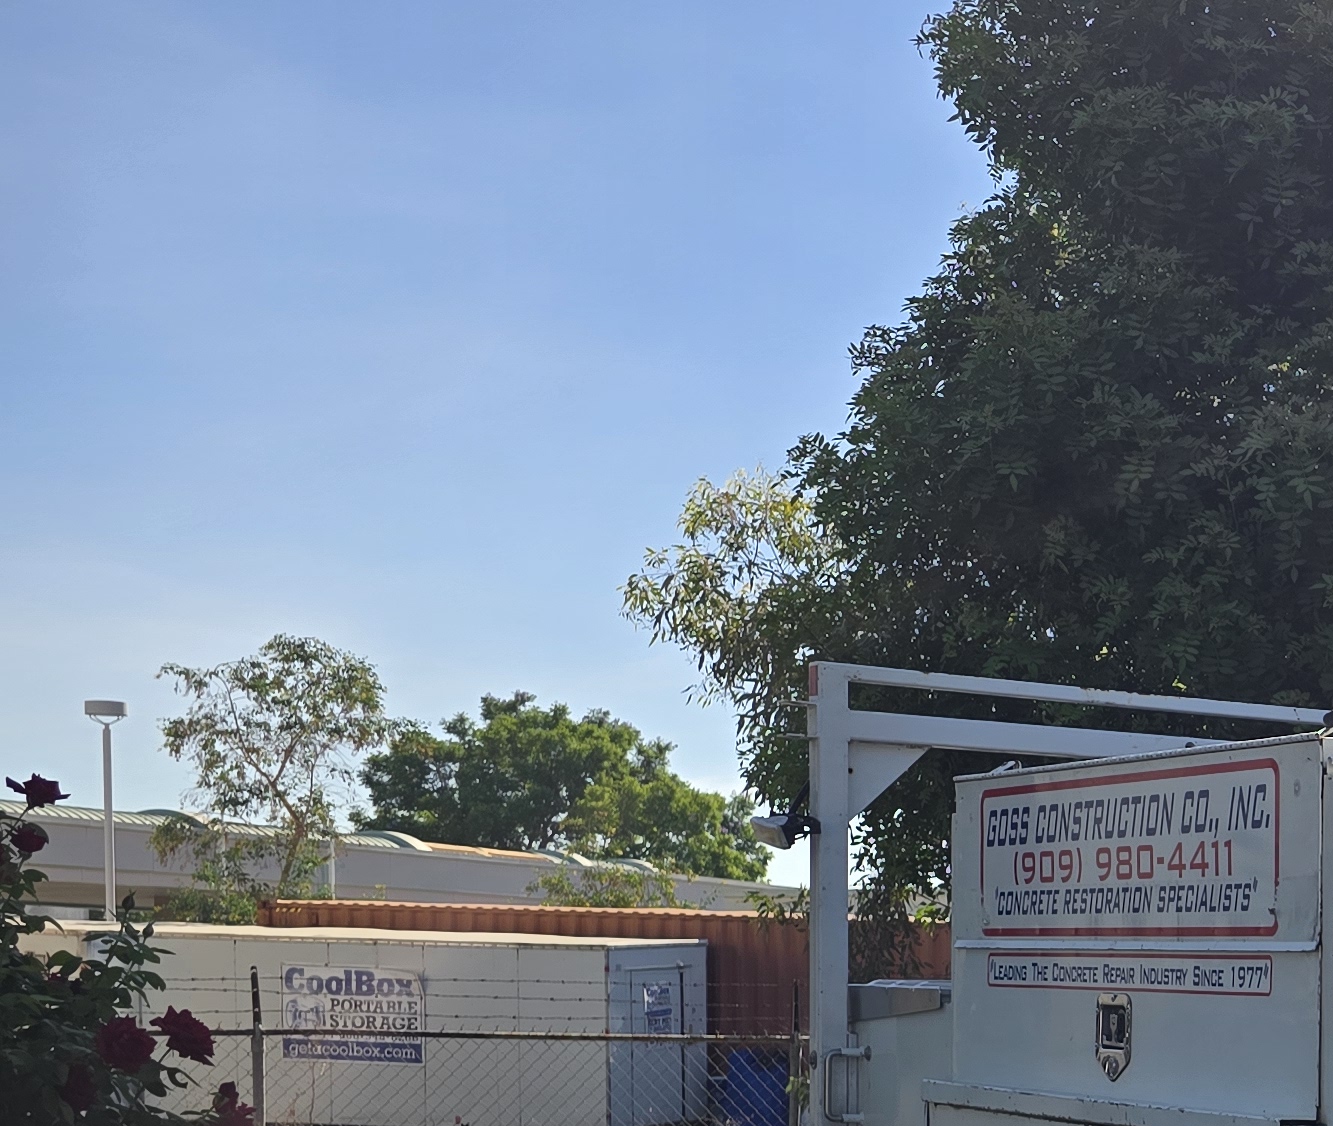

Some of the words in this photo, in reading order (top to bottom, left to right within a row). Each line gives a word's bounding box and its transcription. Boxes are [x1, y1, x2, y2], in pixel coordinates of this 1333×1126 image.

[987, 806, 1030, 847] GOSS
[1036, 792, 1175, 843] CONSTRUCTION
[1228, 784, 1270, 830] INC.
[1014, 847, 1082, 885] (909)
[1096, 840, 1233, 881] 980-4411
[1063, 885, 1153, 914] RESTORATION
[284, 967, 415, 998] CoolBox
[1031, 962, 1049, 981] THE
[1052, 963, 1098, 983] CONCRETE
[1103, 964, 1135, 985] REPAIR
[1140, 964, 1188, 986] INDUSTRY
[1192, 966, 1224, 987] SINCE
[330, 998, 418, 1015] PORTABLE
[330, 1014, 418, 1030] STORAGE
